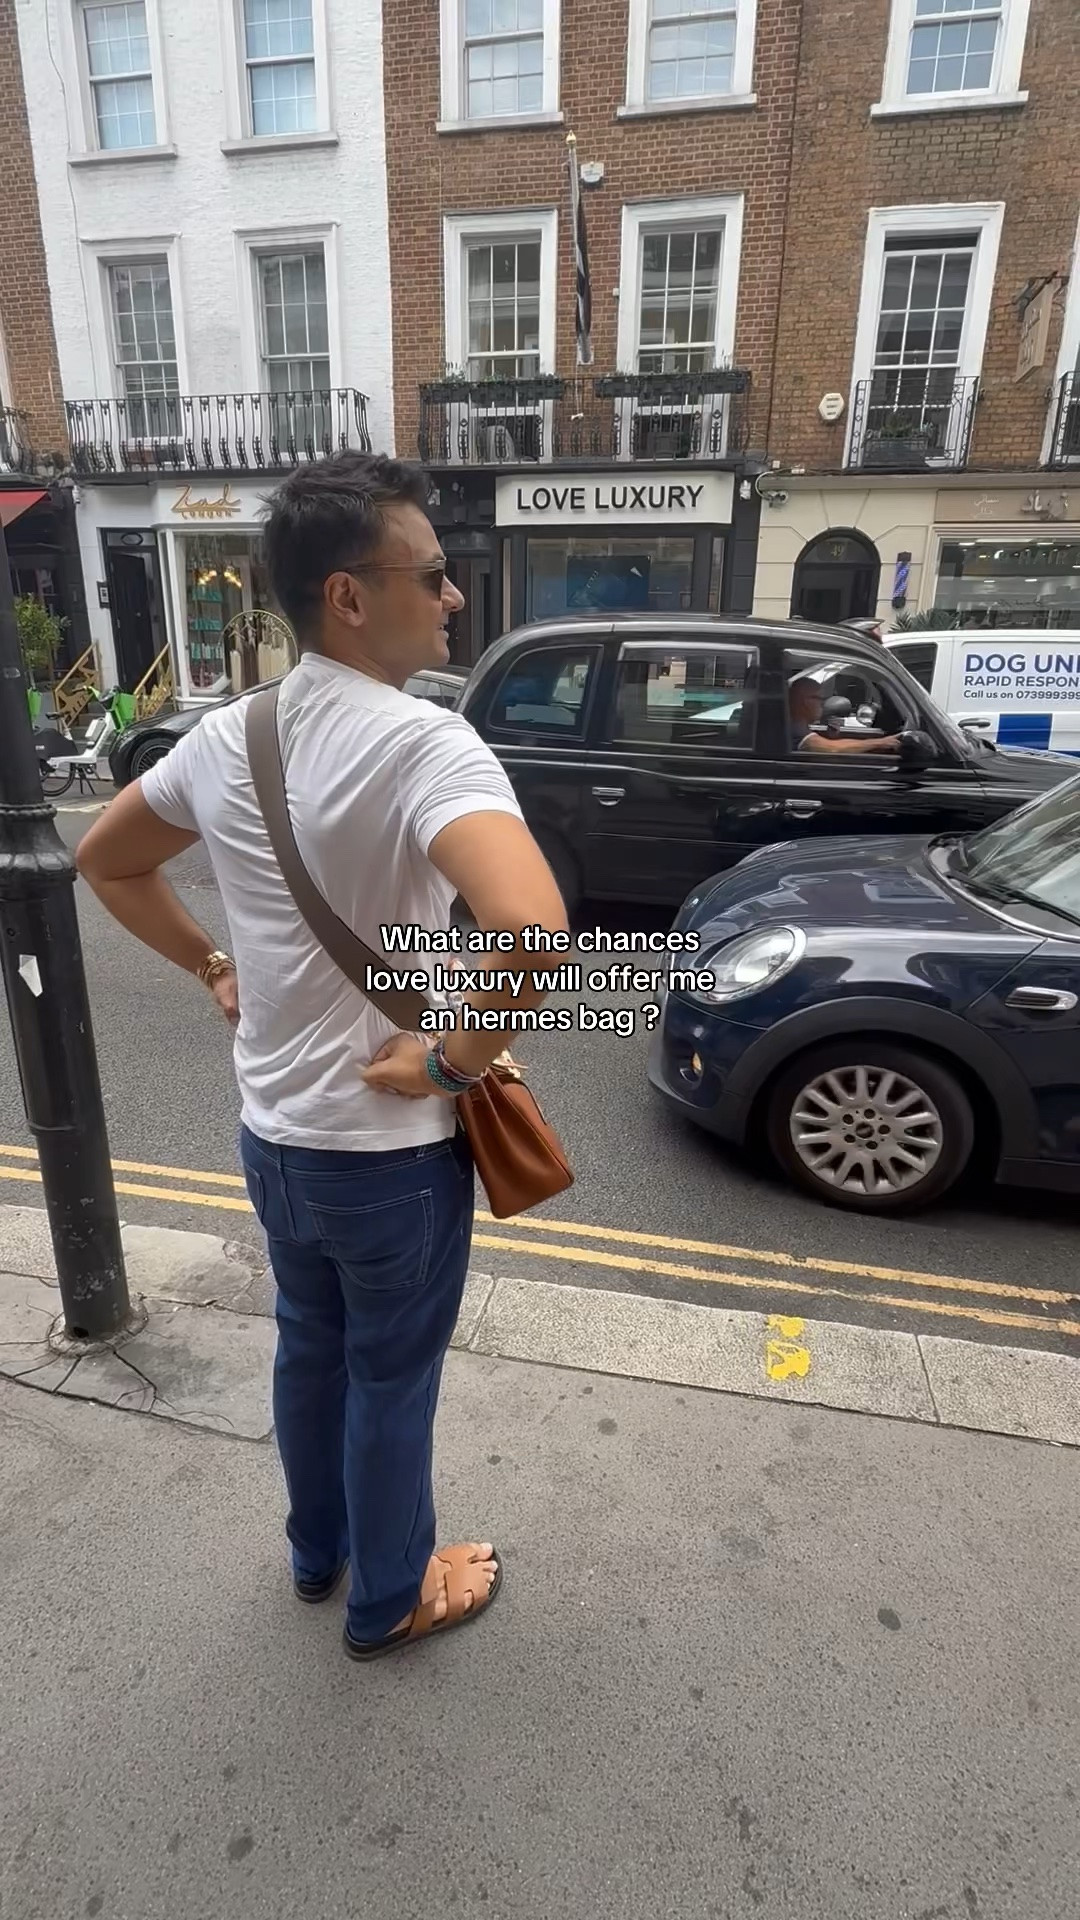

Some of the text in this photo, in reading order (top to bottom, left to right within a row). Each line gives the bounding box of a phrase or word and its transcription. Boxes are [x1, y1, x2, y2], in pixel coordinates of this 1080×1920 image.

[517, 485, 704, 510] LOVE LUXURY
[965, 653, 1026, 673] DOG
[964, 675, 1079, 688] RAPID RESPON
[963, 690, 984, 699] Call
[986, 691, 998, 699] us
[1000, 691, 1014, 699] on
